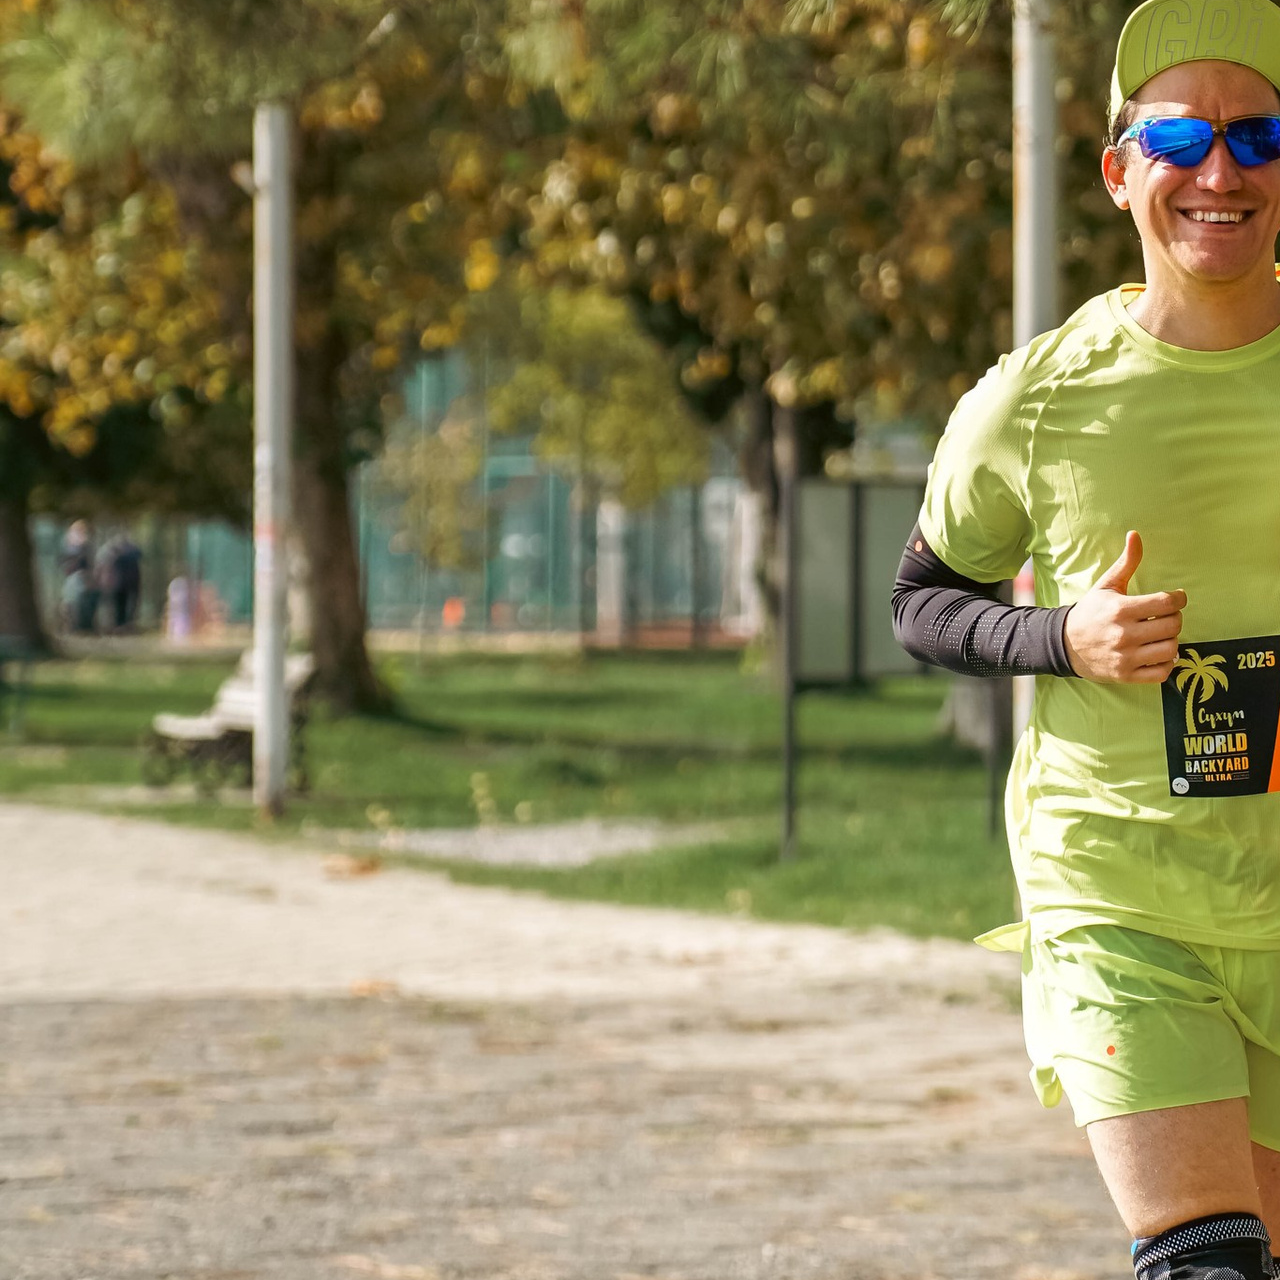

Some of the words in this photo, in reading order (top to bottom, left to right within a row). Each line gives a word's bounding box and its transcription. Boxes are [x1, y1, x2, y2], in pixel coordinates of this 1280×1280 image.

[1237, 651, 1276, 670] 2025
[1184, 733, 1248, 756] WORLD
[1185, 757, 1249, 773] BACKYARD
[1205, 773, 1232, 782] ULTRA
